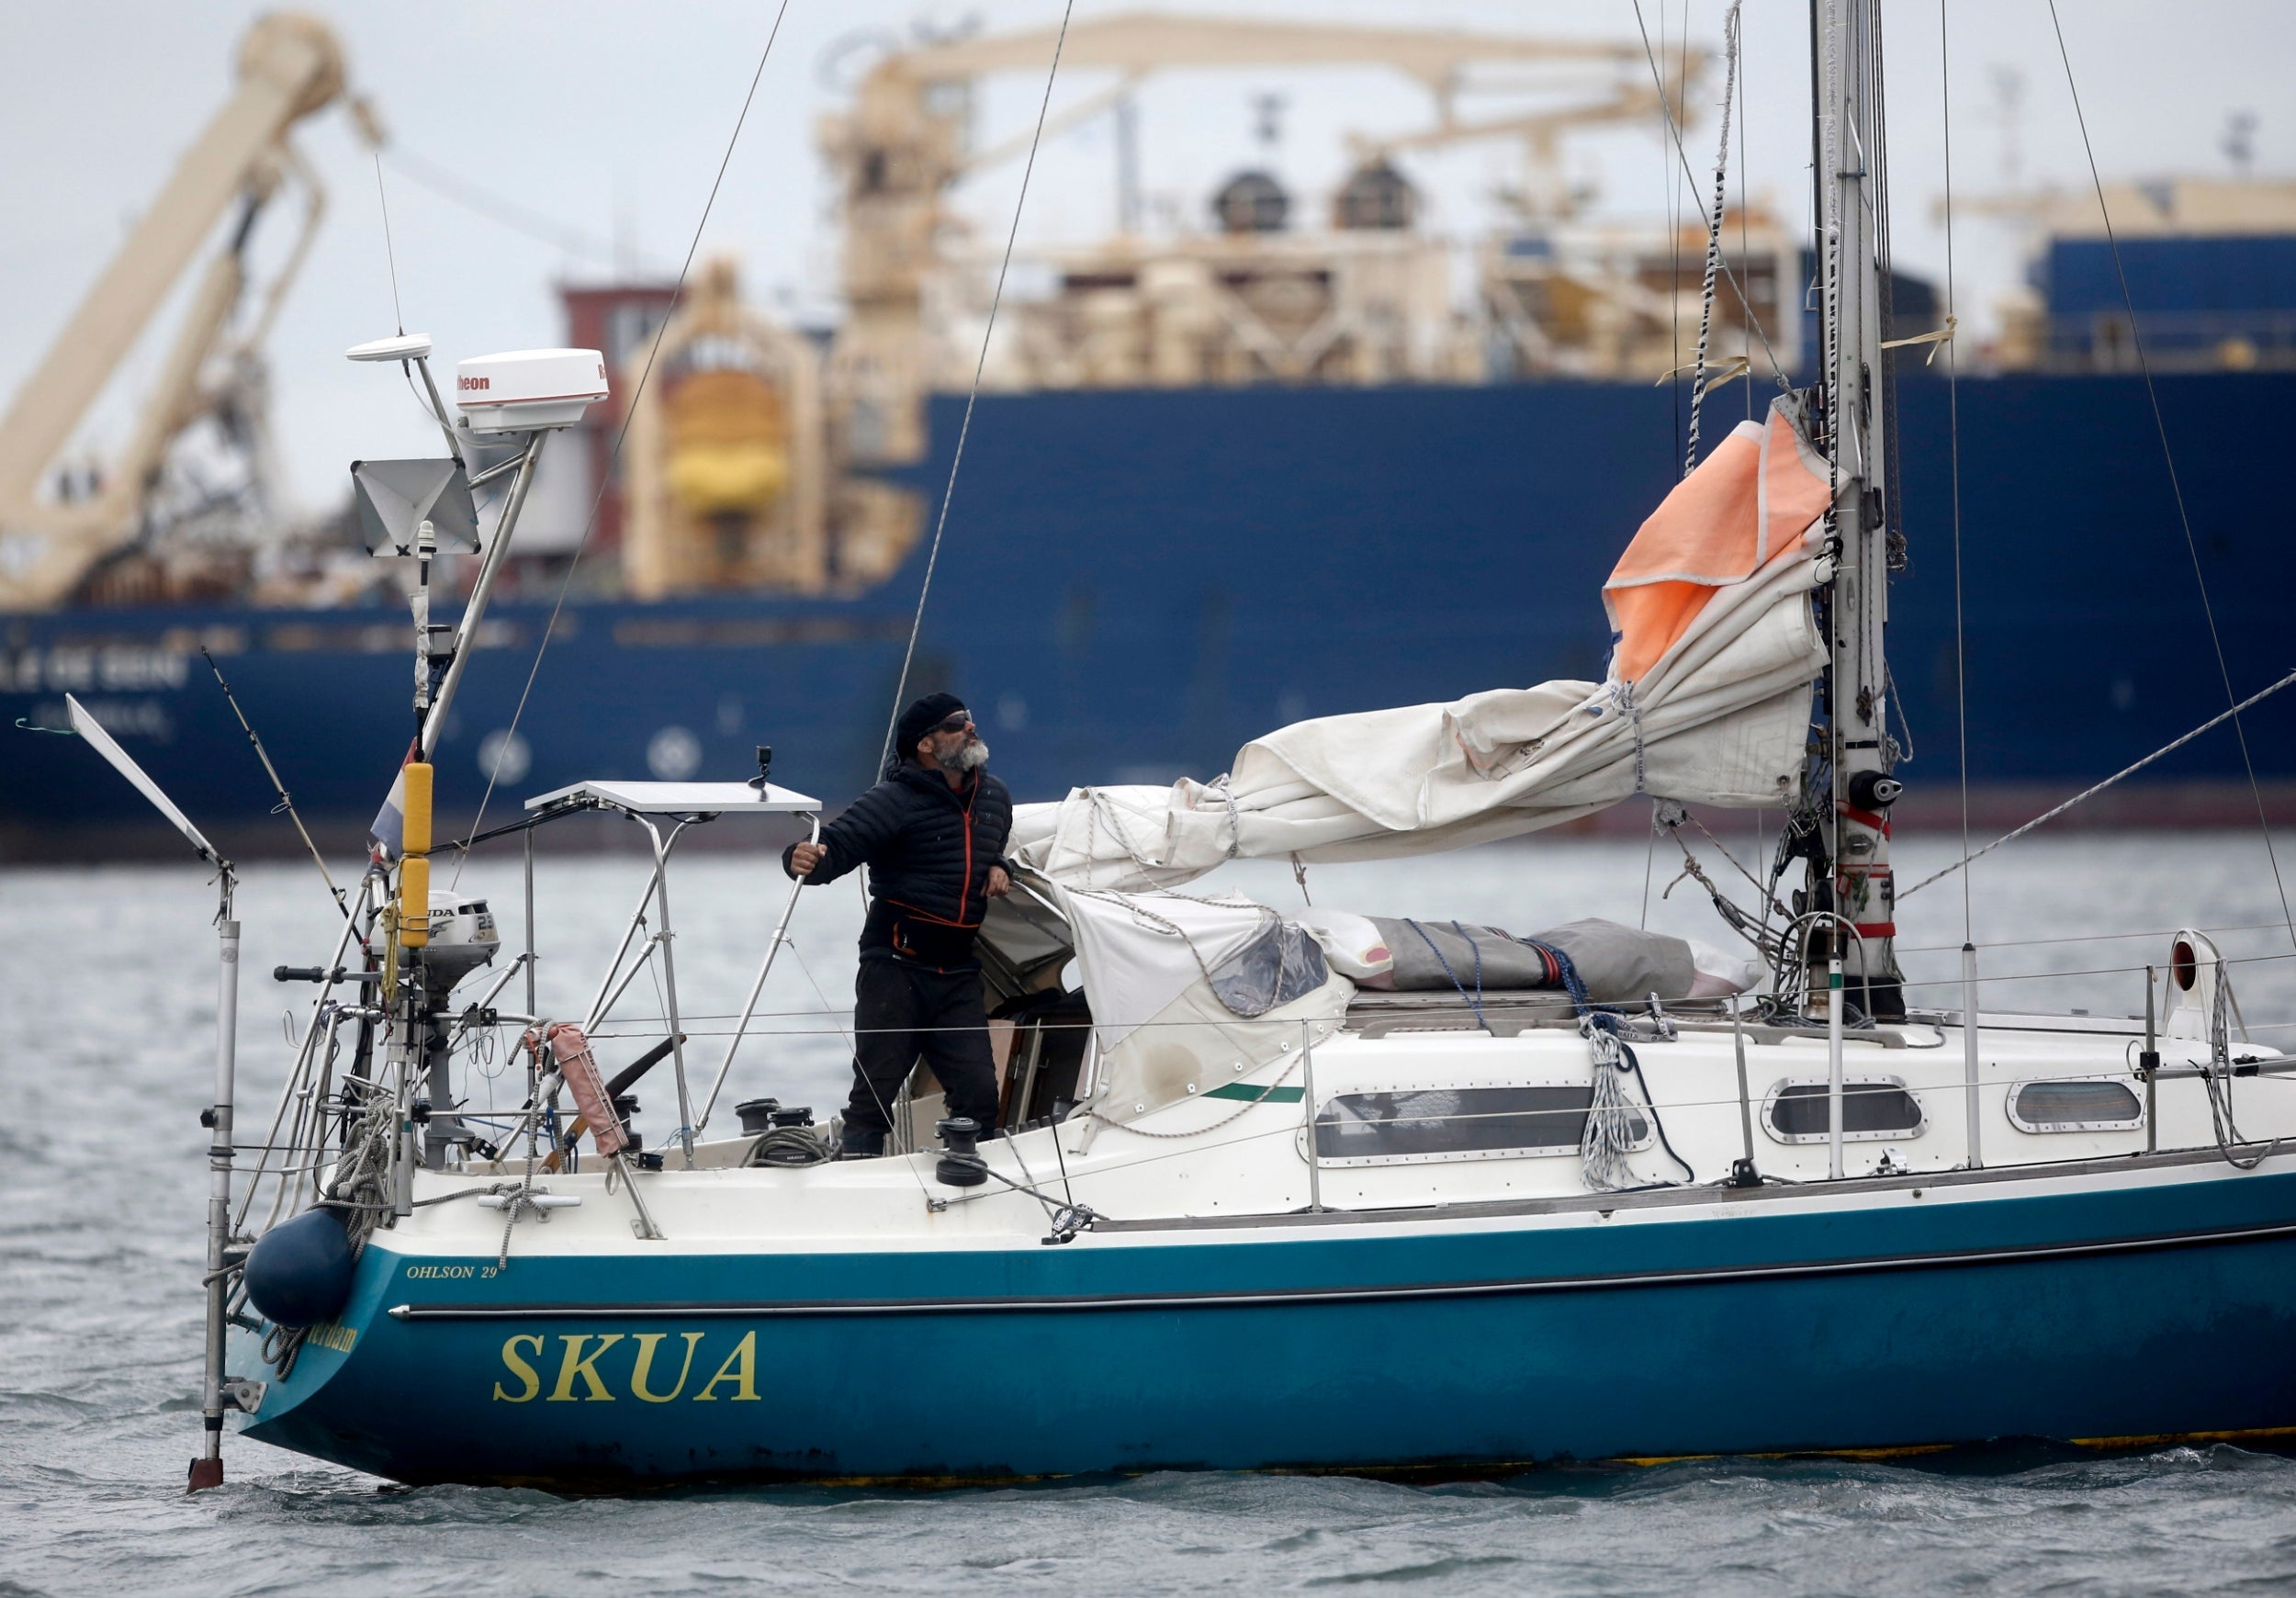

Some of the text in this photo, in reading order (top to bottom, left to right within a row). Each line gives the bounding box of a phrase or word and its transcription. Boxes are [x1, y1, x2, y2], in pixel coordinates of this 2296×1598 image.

[457, 375, 490, 390] heon
[407, 1266, 498, 1278] OHLSON 29
[493, 1331, 761, 1402] SKUA
